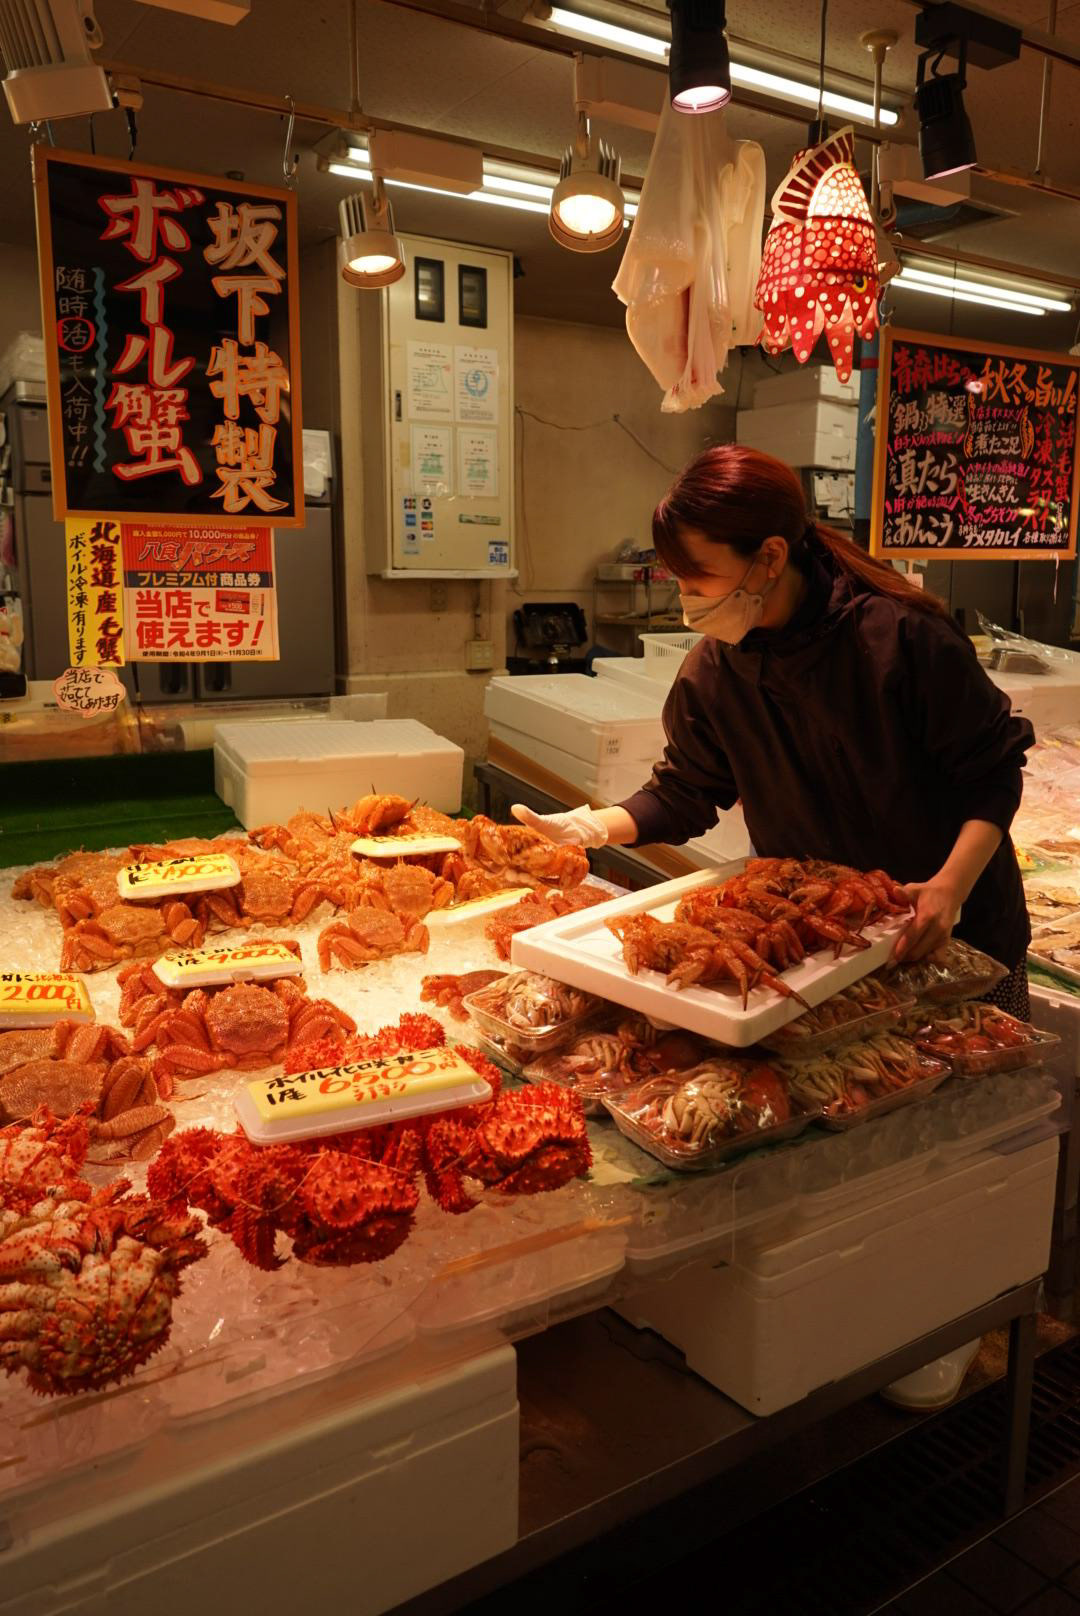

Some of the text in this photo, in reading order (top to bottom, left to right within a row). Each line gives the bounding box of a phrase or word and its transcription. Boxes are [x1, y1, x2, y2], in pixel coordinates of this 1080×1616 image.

[98, 177, 206, 487] ボイル蟹
[202, 201, 290, 513] 坂下特製
[893, 511, 954, 547] あんこう
[894, 448, 958, 497] 真たら
[69, 532, 88, 665] ボイル冷凍有ります
[89, 521, 122, 665] 北海道産毛蟹
[136, 590, 211, 619] 当店で
